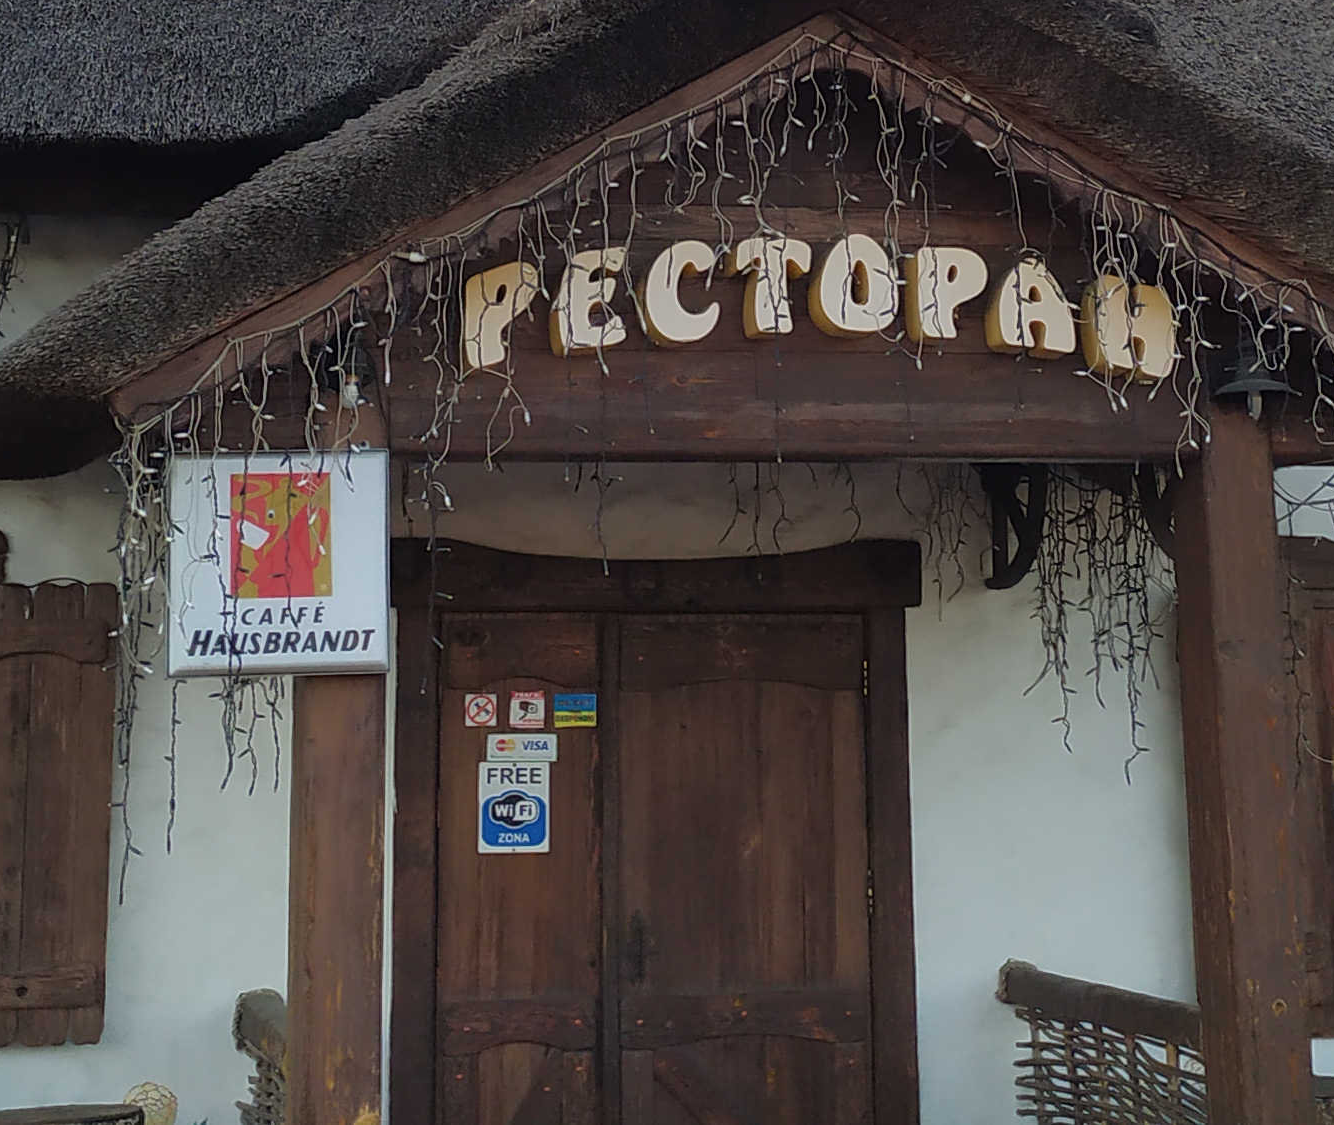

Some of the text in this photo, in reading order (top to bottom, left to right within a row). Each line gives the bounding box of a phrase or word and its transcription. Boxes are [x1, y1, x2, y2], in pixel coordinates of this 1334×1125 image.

[464, 232, 1177, 380] РЕСТОРАН
[241, 601, 326, 626] CAFFÉ
[187, 628, 376, 657] HAUSBRANDT
[522, 740, 549, 751] VISA
[487, 767, 542, 785] FREE
[498, 832, 530, 843] ZONA
